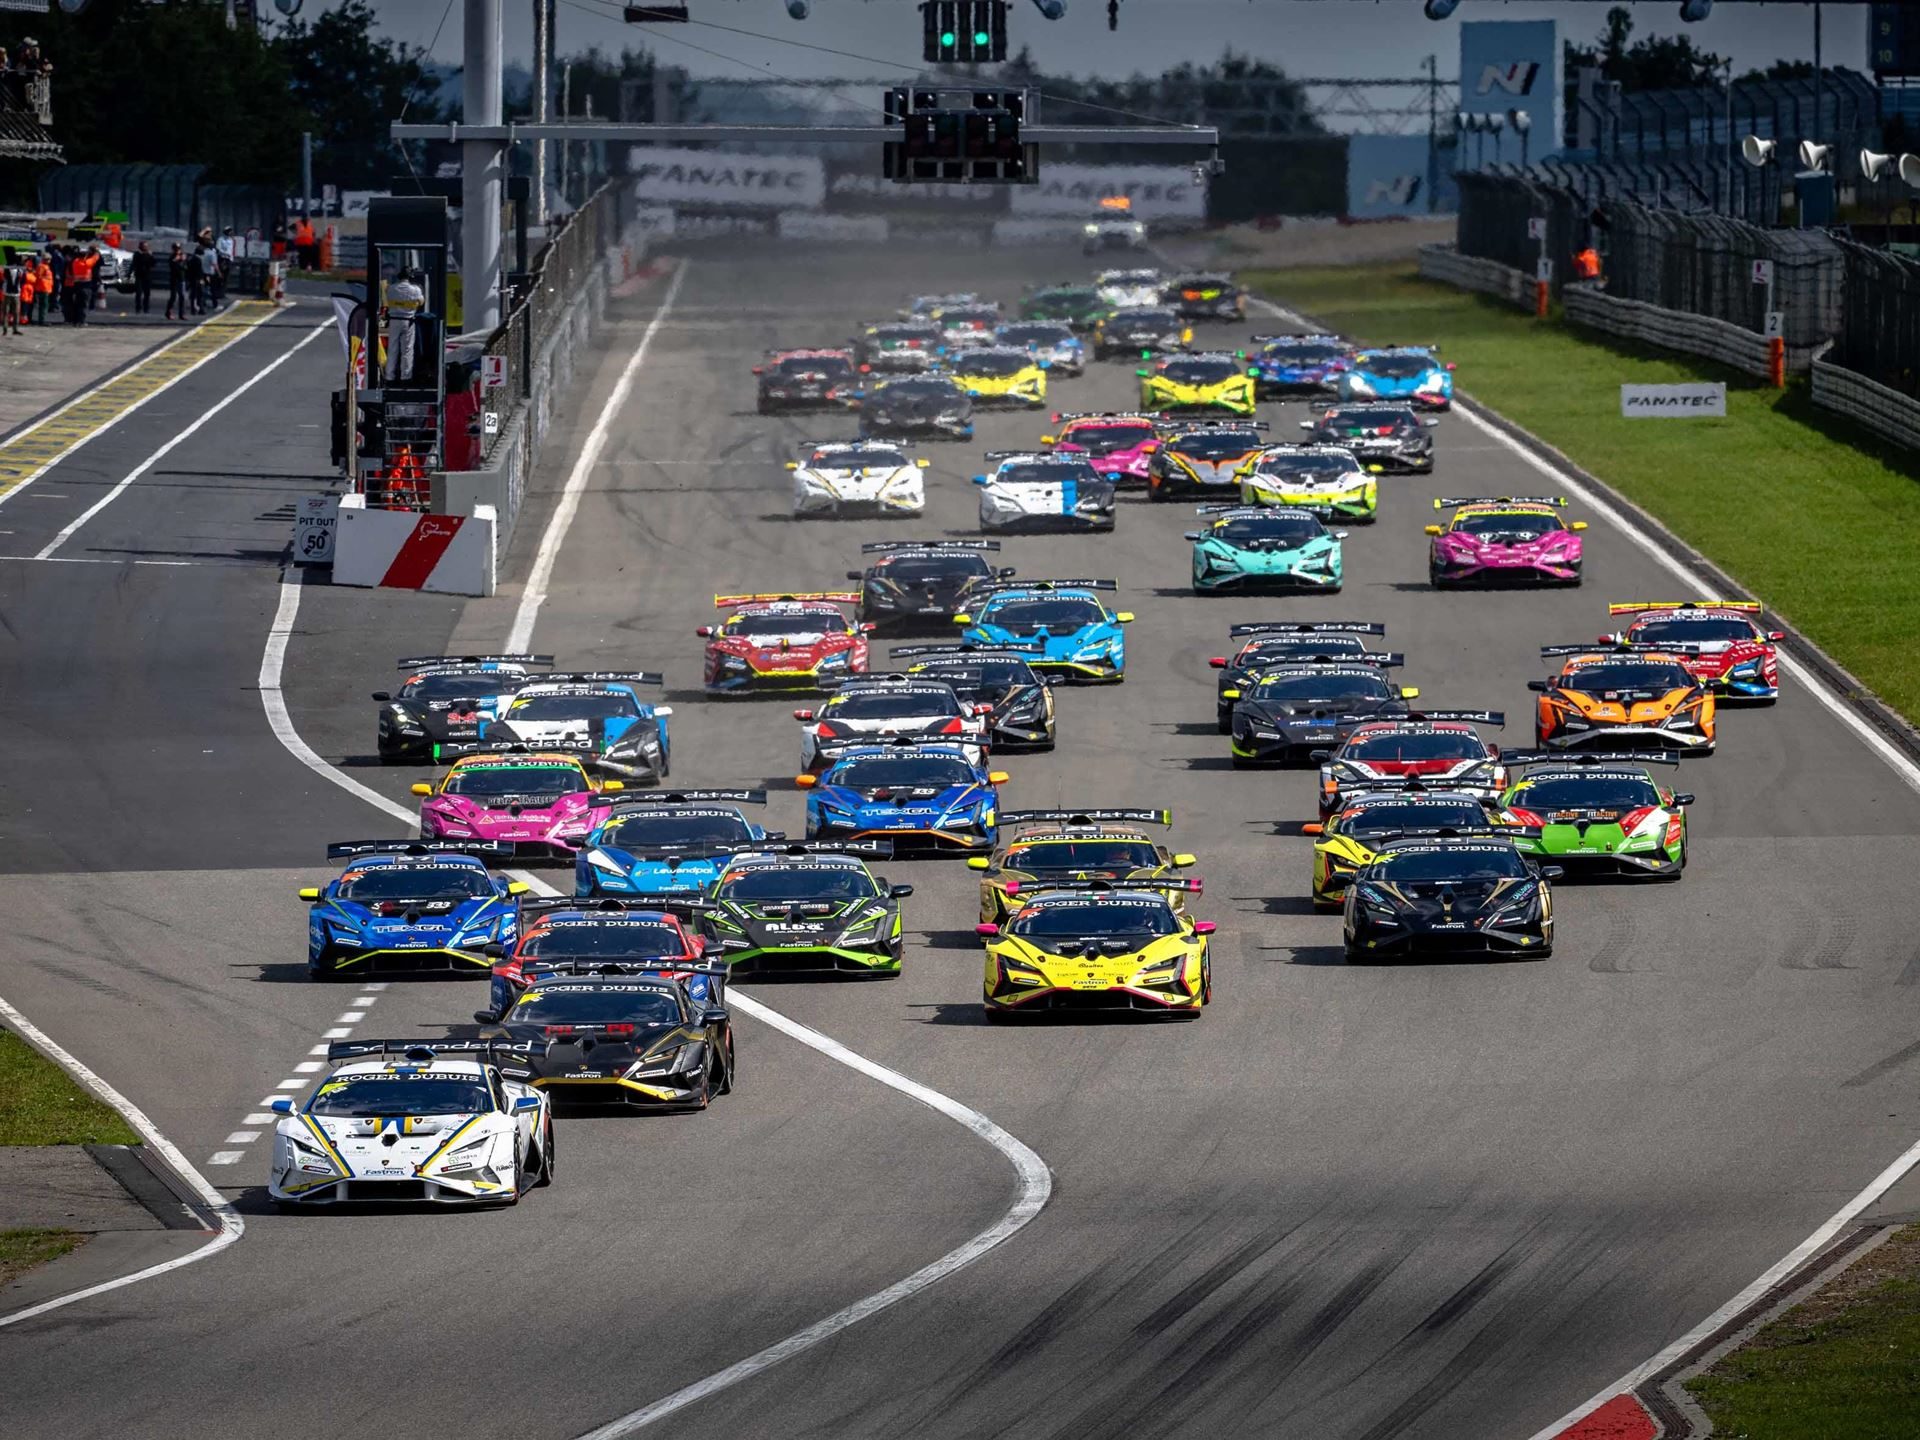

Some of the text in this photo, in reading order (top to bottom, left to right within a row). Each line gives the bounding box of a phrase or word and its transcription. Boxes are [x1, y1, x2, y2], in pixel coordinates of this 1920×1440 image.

[1769, 316, 1778, 331] 2
[1627, 394, 1718, 407] FANATEC
[486, 414, 497, 427] 2a
[299, 517, 335, 526] PIT OUT
[307, 535, 325, 549] 50
[549, 672, 643, 681] radstad
[1387, 712, 1489, 720] radstad
[1563, 752, 1666, 760] radstad
[645, 791, 750, 800] radstad
[617, 811, 669, 819] ROGER
[1418, 826, 1526, 834] radstad
[389, 841, 498, 850] radstad
[764, 841, 877, 850] radstad
[1386, 846, 1440, 854] ROGER
[534, 985, 668, 993] ROGER DUBUIS
[335, 1074, 480, 1082] ROGER DUBUIS
